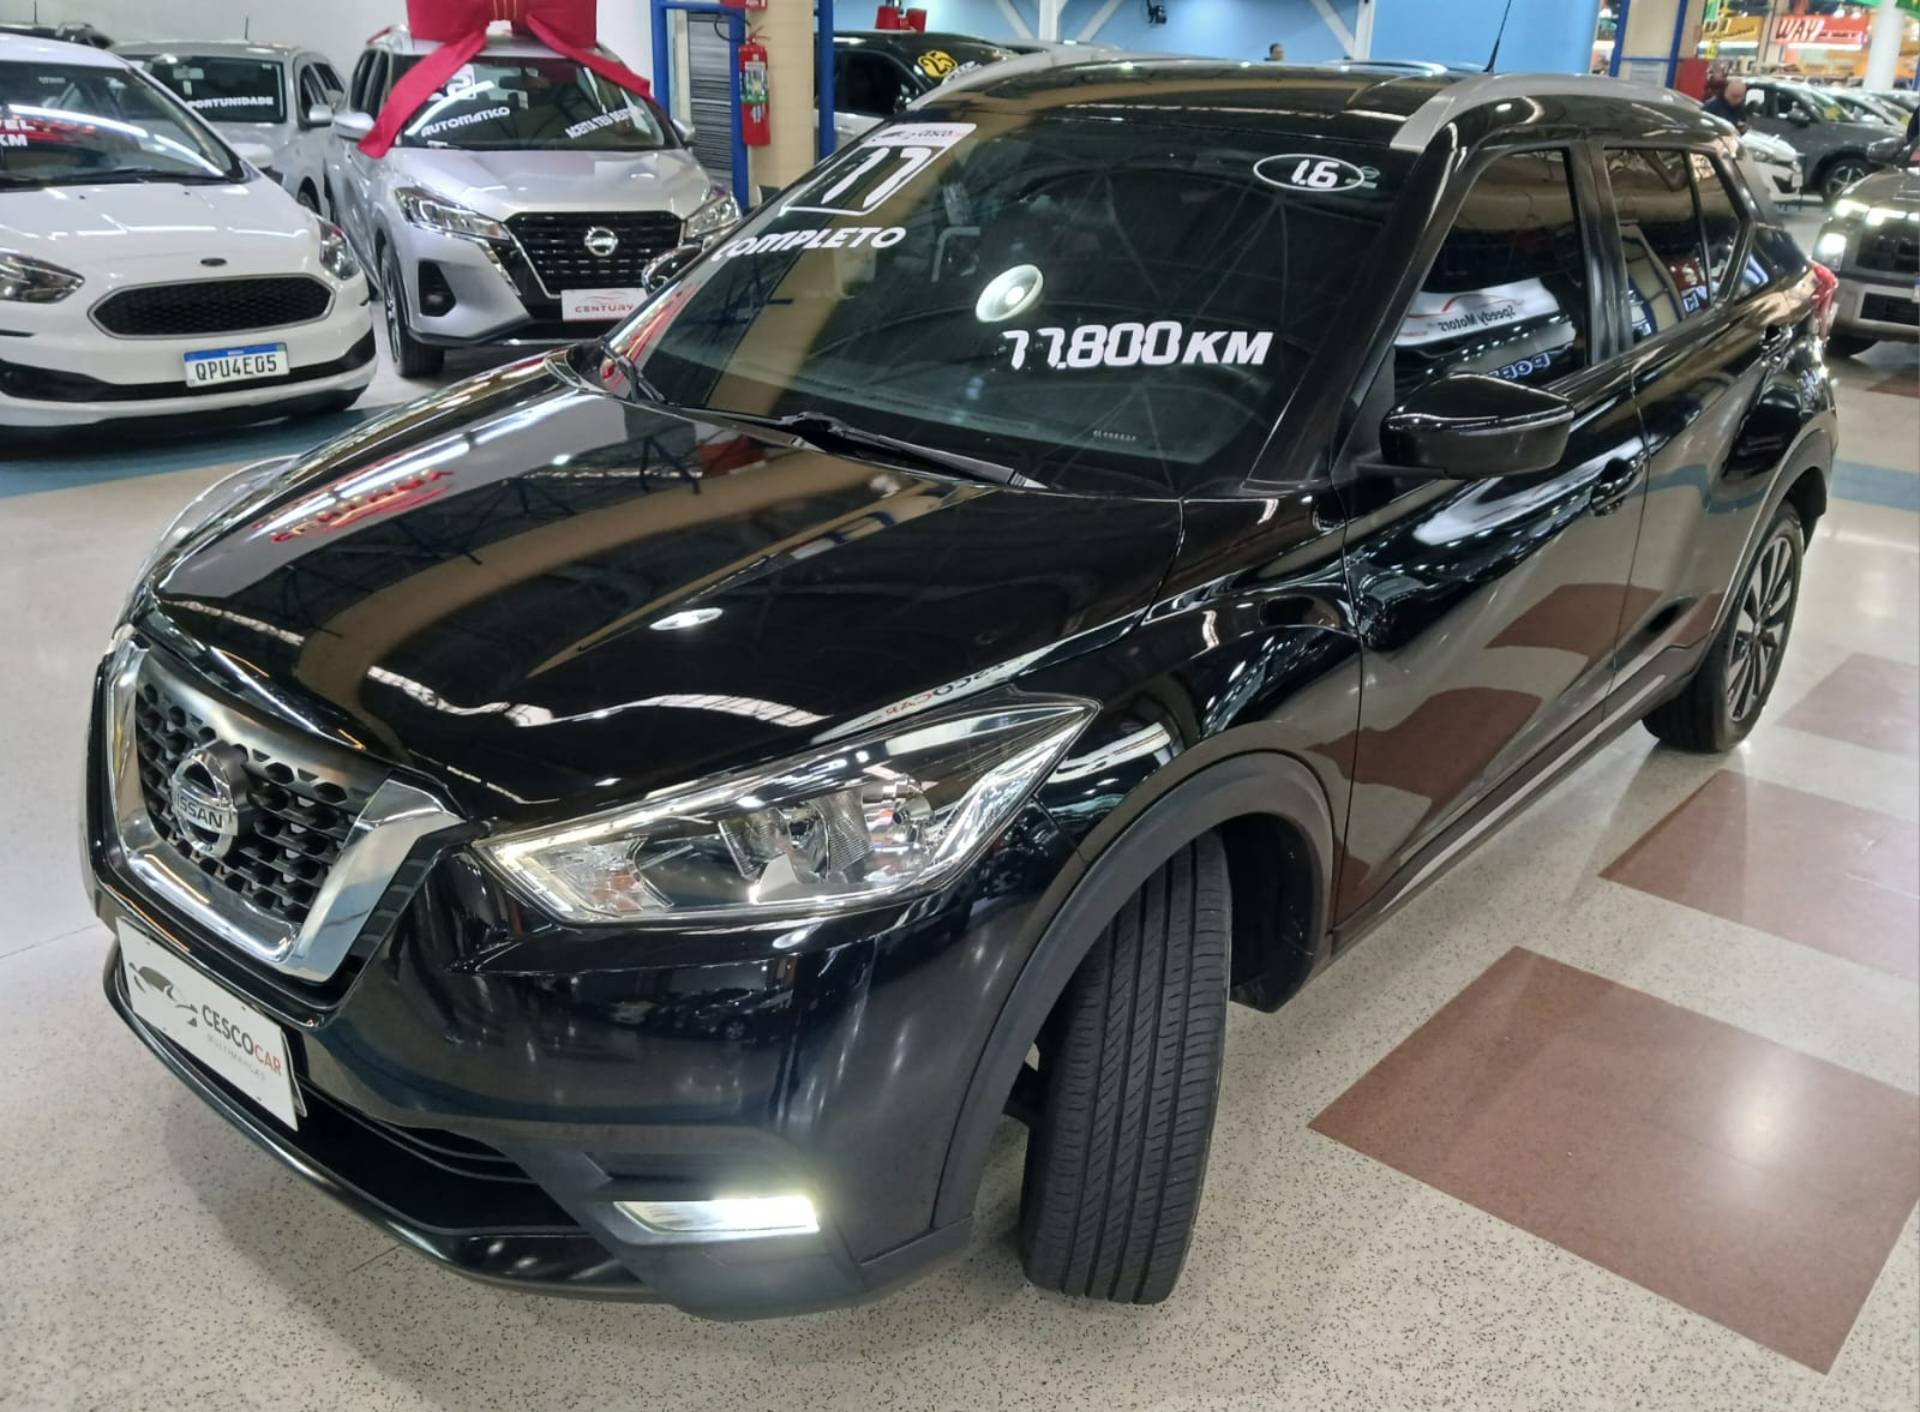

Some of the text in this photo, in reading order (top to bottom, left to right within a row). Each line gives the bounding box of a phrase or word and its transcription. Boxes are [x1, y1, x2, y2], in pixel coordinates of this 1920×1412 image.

[1776, 18, 1824, 41] WAY
[820, 146, 933, 209] 17
[1291, 159, 1340, 188] 1.6
[711, 226, 907, 262] COMPLETO
[575, 304, 634, 313] CENTURY
[176, 792, 223, 829] ISSAN
[202, 1004, 282, 1075] CESCOCAR
